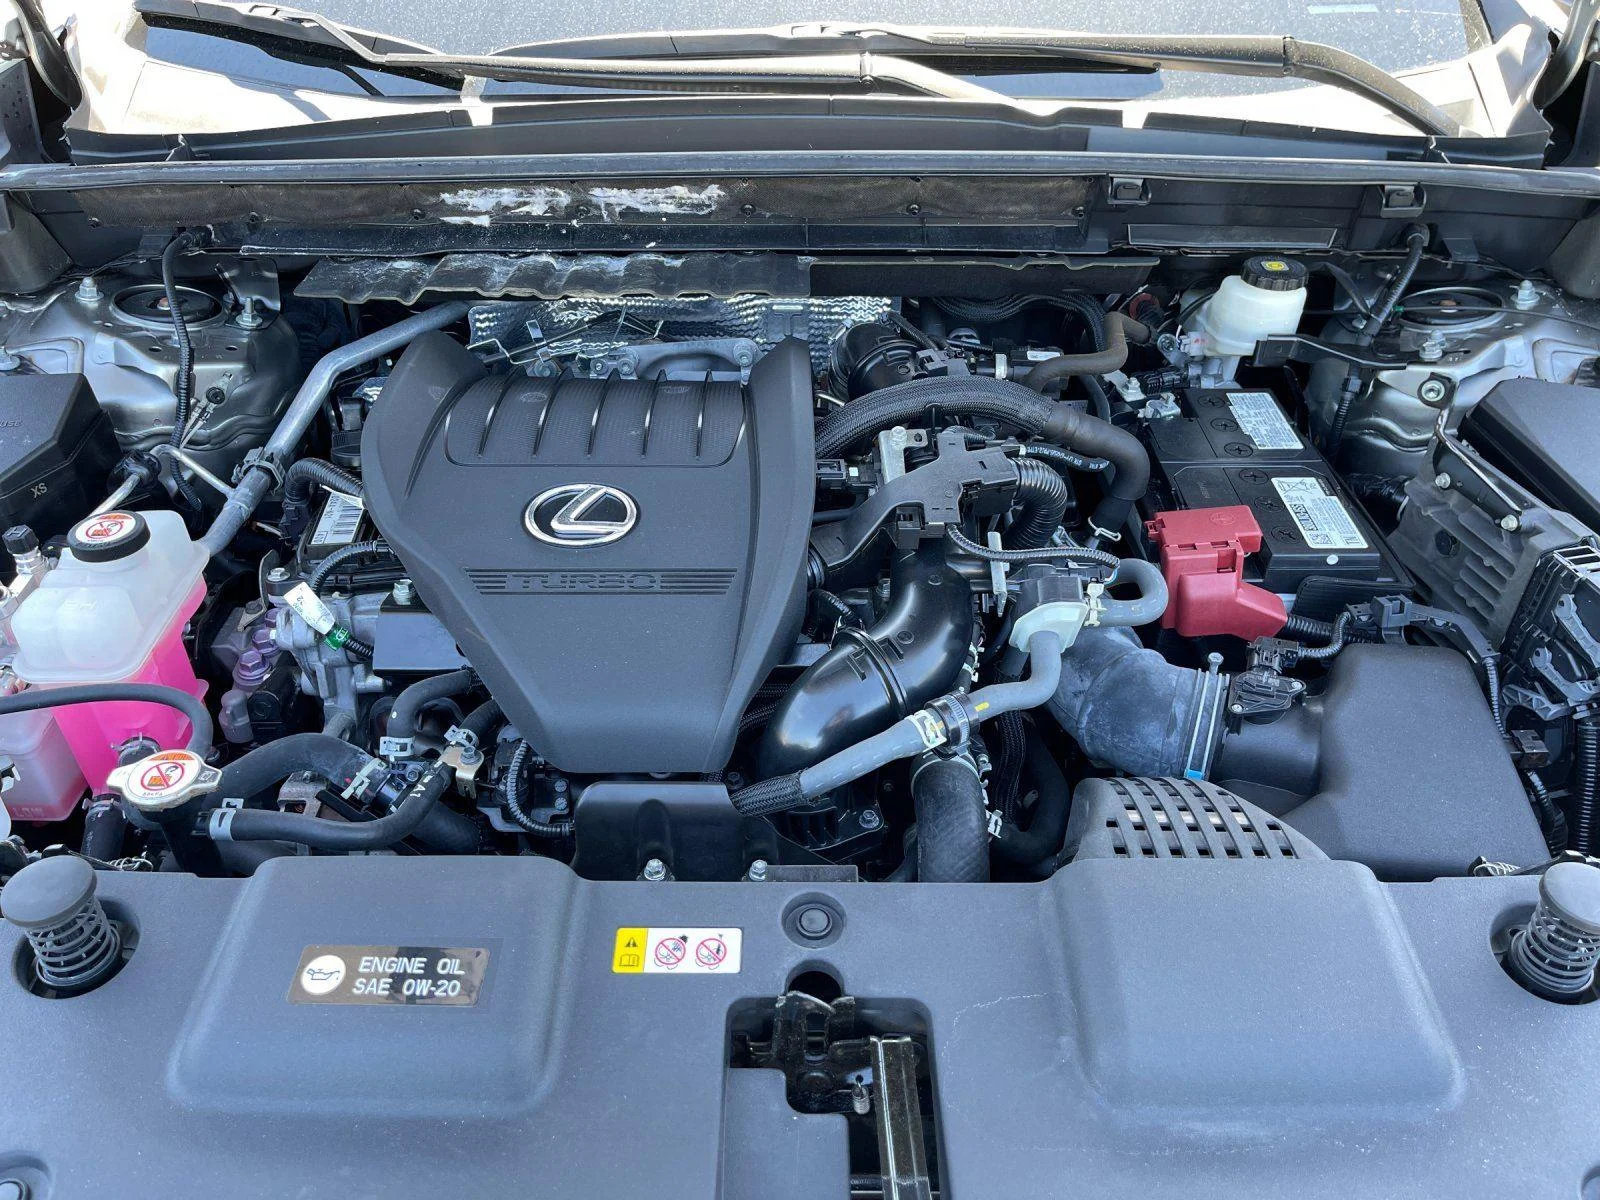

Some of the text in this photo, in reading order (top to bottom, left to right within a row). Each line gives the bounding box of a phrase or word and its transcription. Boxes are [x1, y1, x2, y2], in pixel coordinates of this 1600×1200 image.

[30, 482, 48, 498] XS
[512, 573, 657, 589] TURBO
[358, 956, 466, 975] ENGINE OIL
[352, 978, 461, 996] SAE 0W-20
